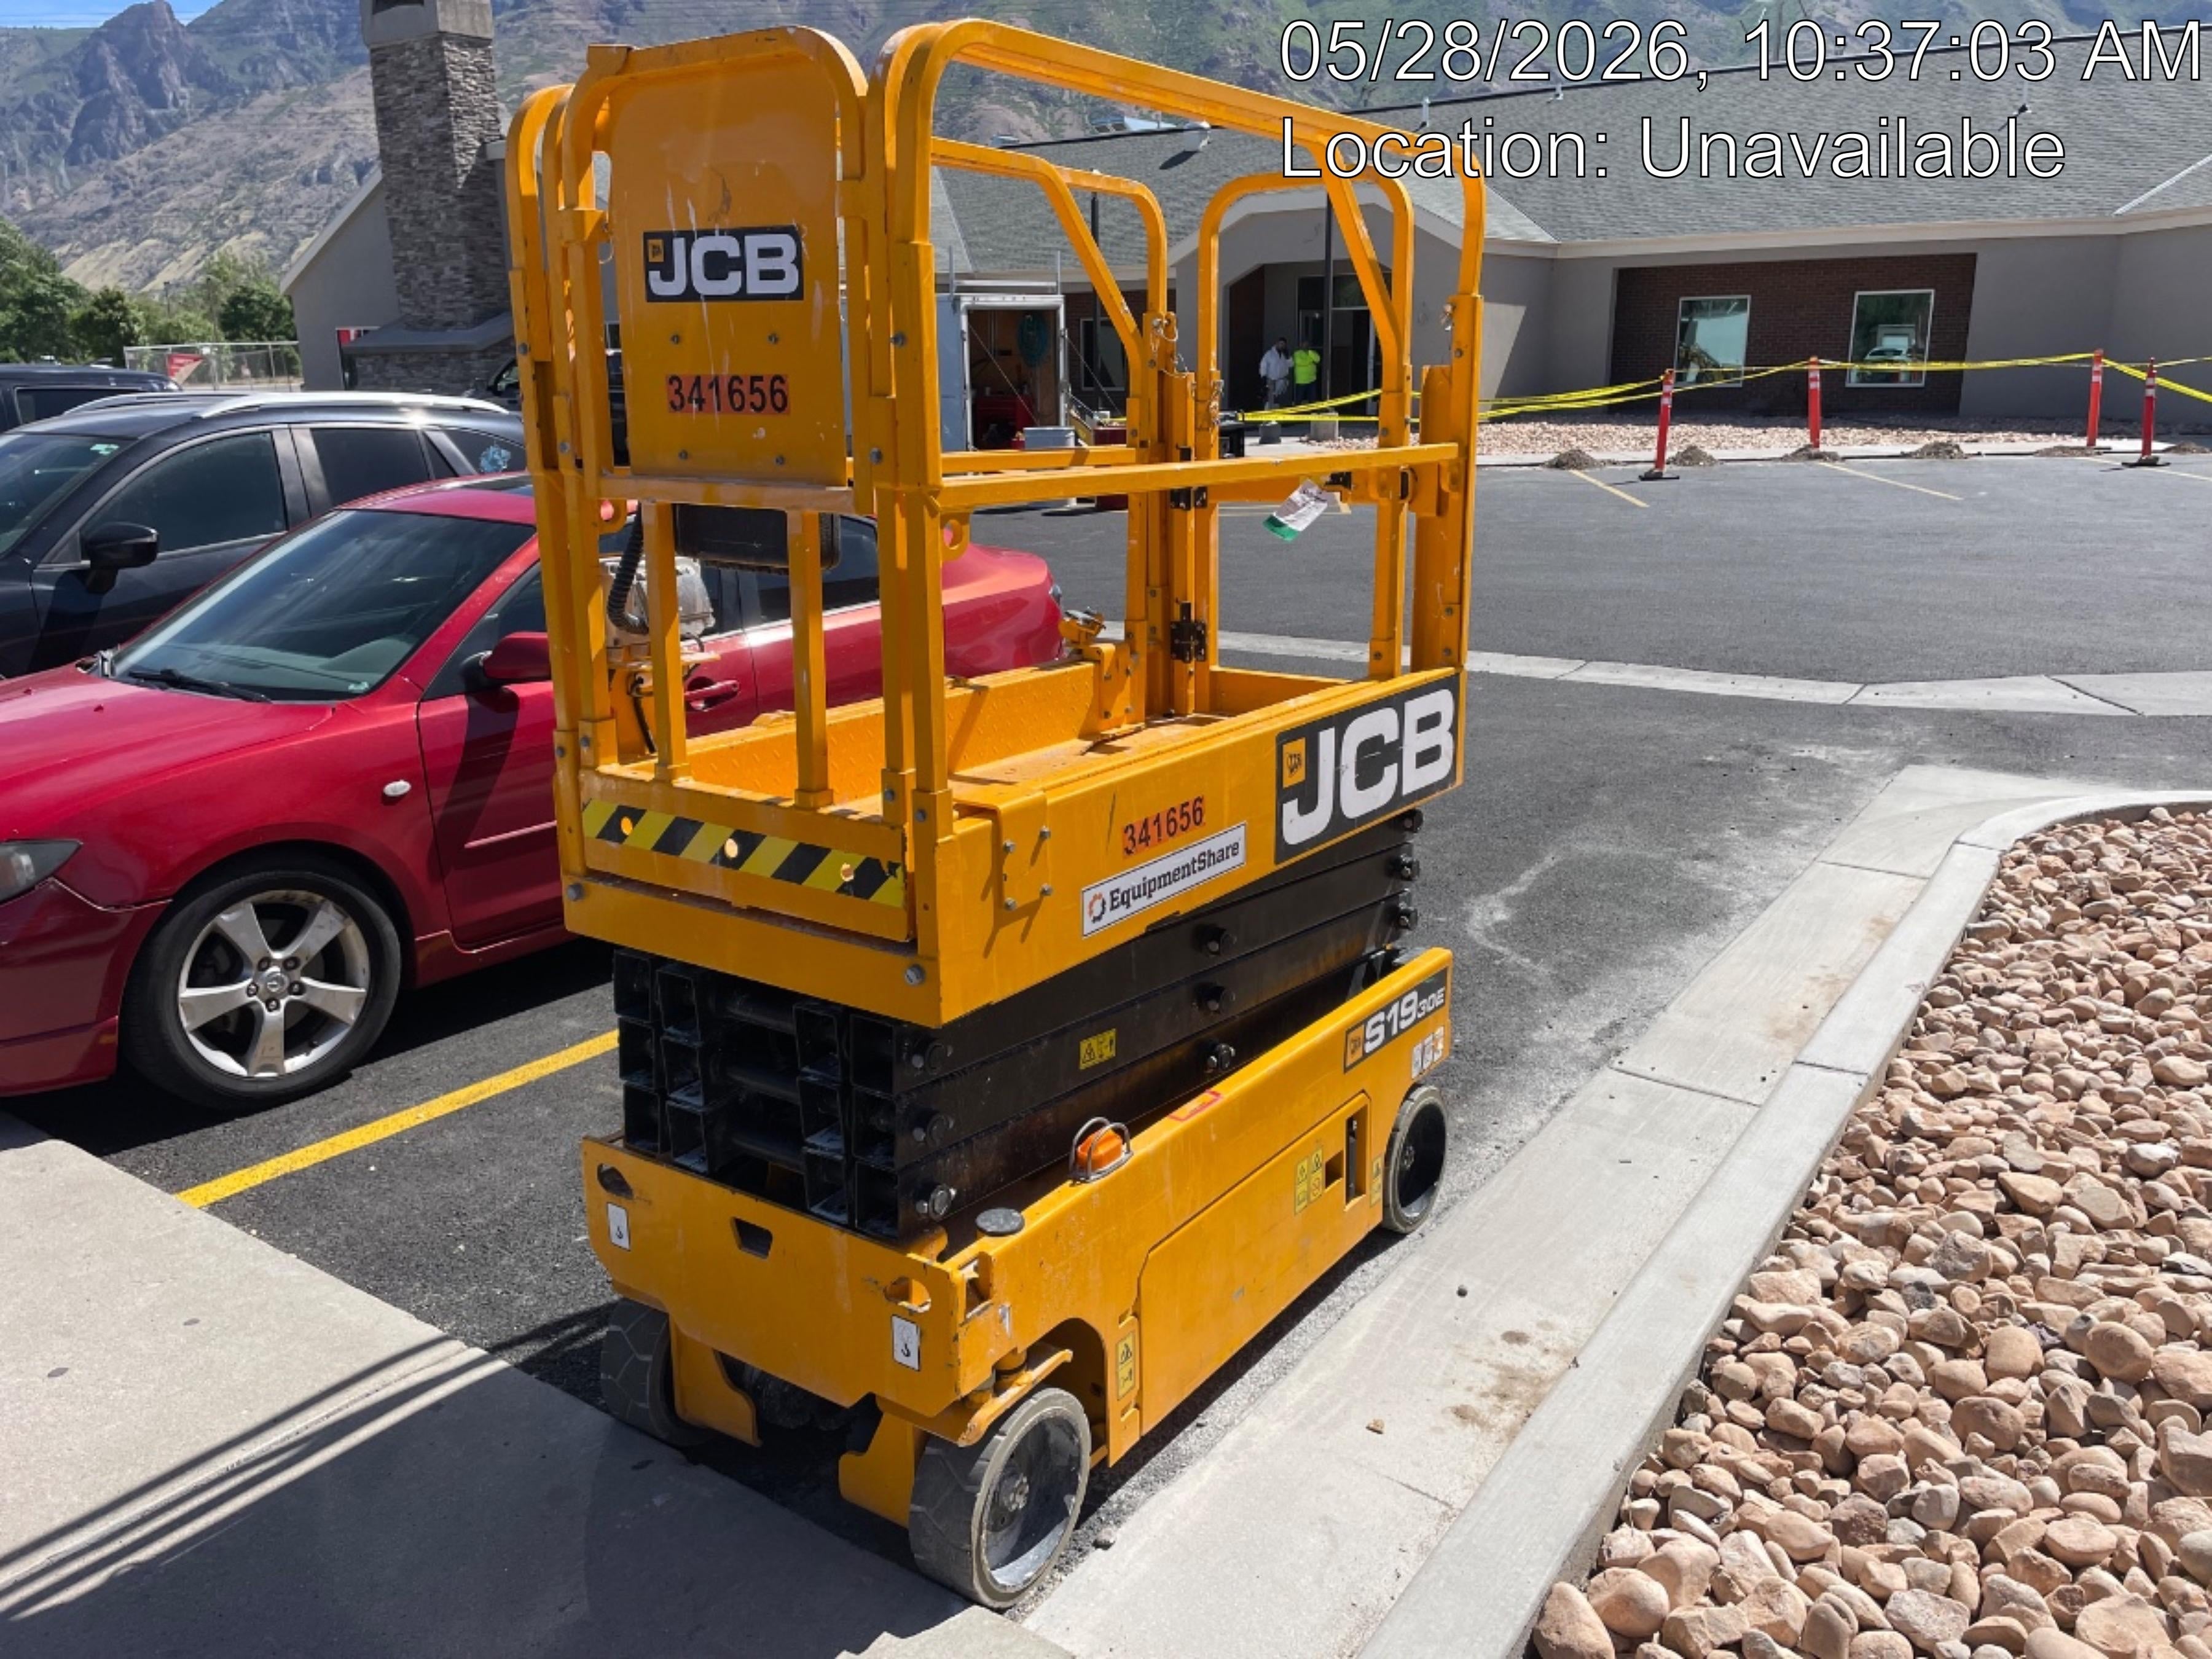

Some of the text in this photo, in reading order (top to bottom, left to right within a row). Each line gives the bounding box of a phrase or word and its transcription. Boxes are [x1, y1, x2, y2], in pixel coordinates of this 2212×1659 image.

[648, 233, 799, 296] JCB
[669, 375, 788, 412] 341656
[1282, 688, 1455, 845] JCB
[1123, 796, 1204, 855] 341656
[1108, 841, 1240, 911] EquipmentShare
